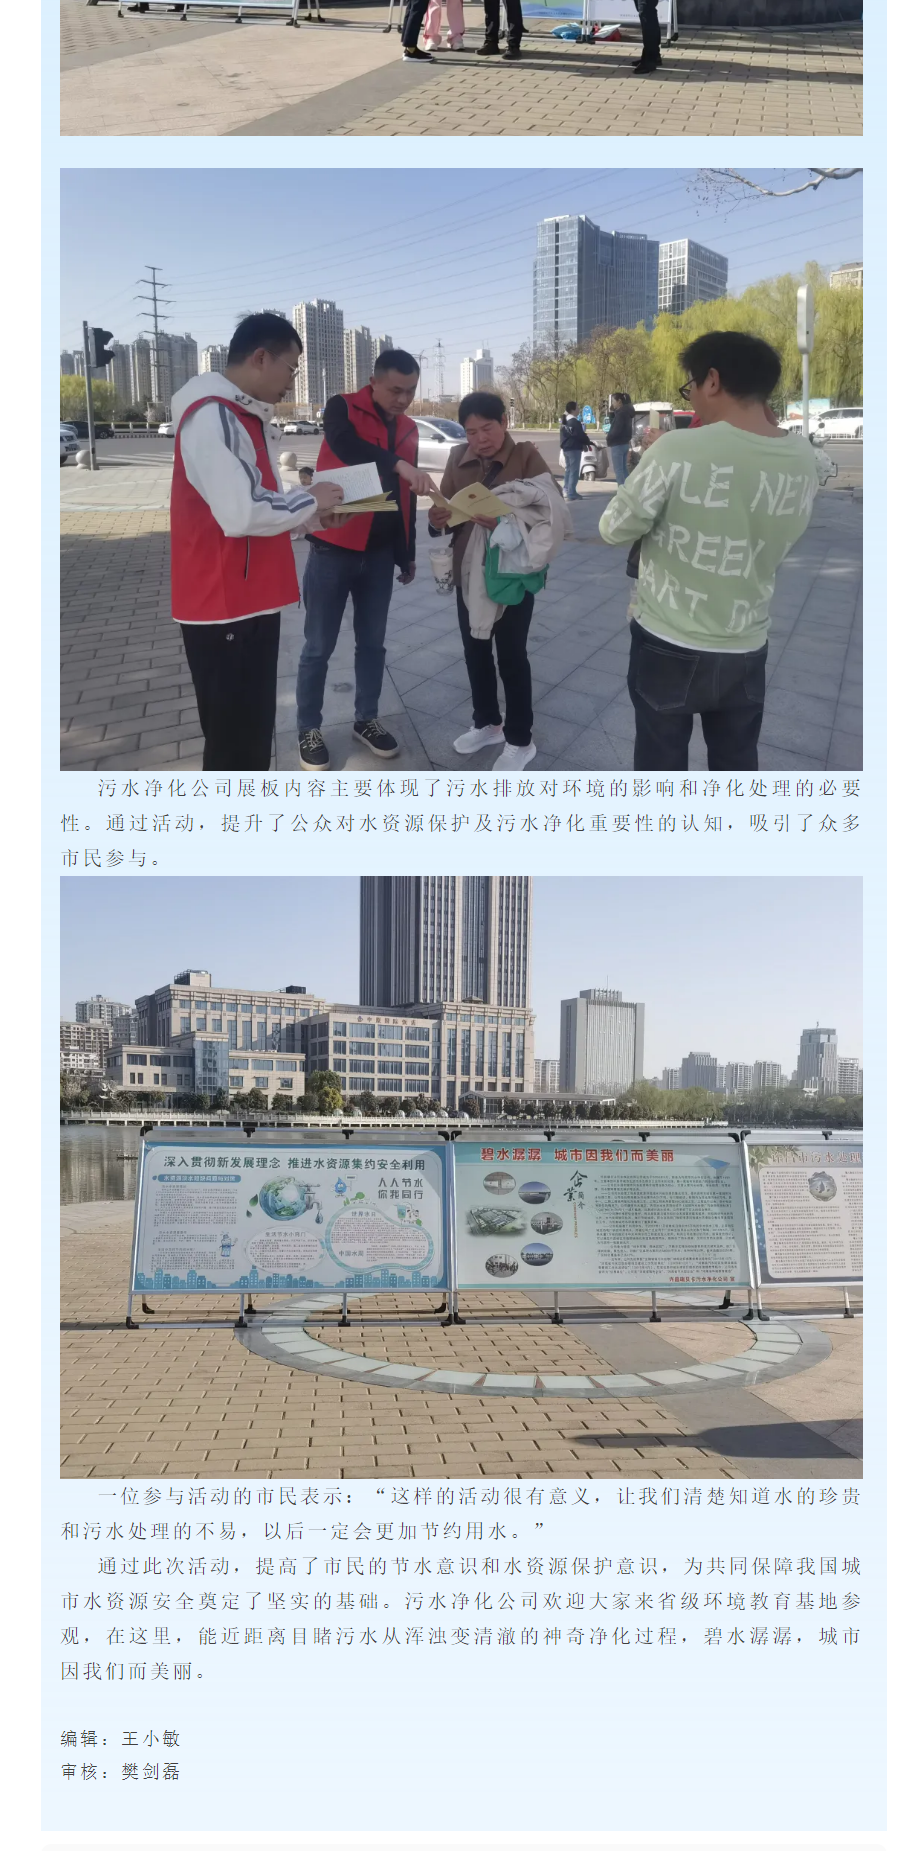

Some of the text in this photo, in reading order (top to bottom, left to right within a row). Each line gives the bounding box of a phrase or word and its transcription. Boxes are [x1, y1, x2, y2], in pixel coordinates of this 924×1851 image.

[481, 1147, 675, 1162] 碧水潺潺 城市因我们而美丽
[163, 1156, 425, 1171] 深入贯彻新发展理念 推进水资源集约安全利用
[378, 1177, 423, 1188] 人人节水
[378, 1189, 423, 1200] 你我同行
[338, 1249, 364, 1257] 中国水周
